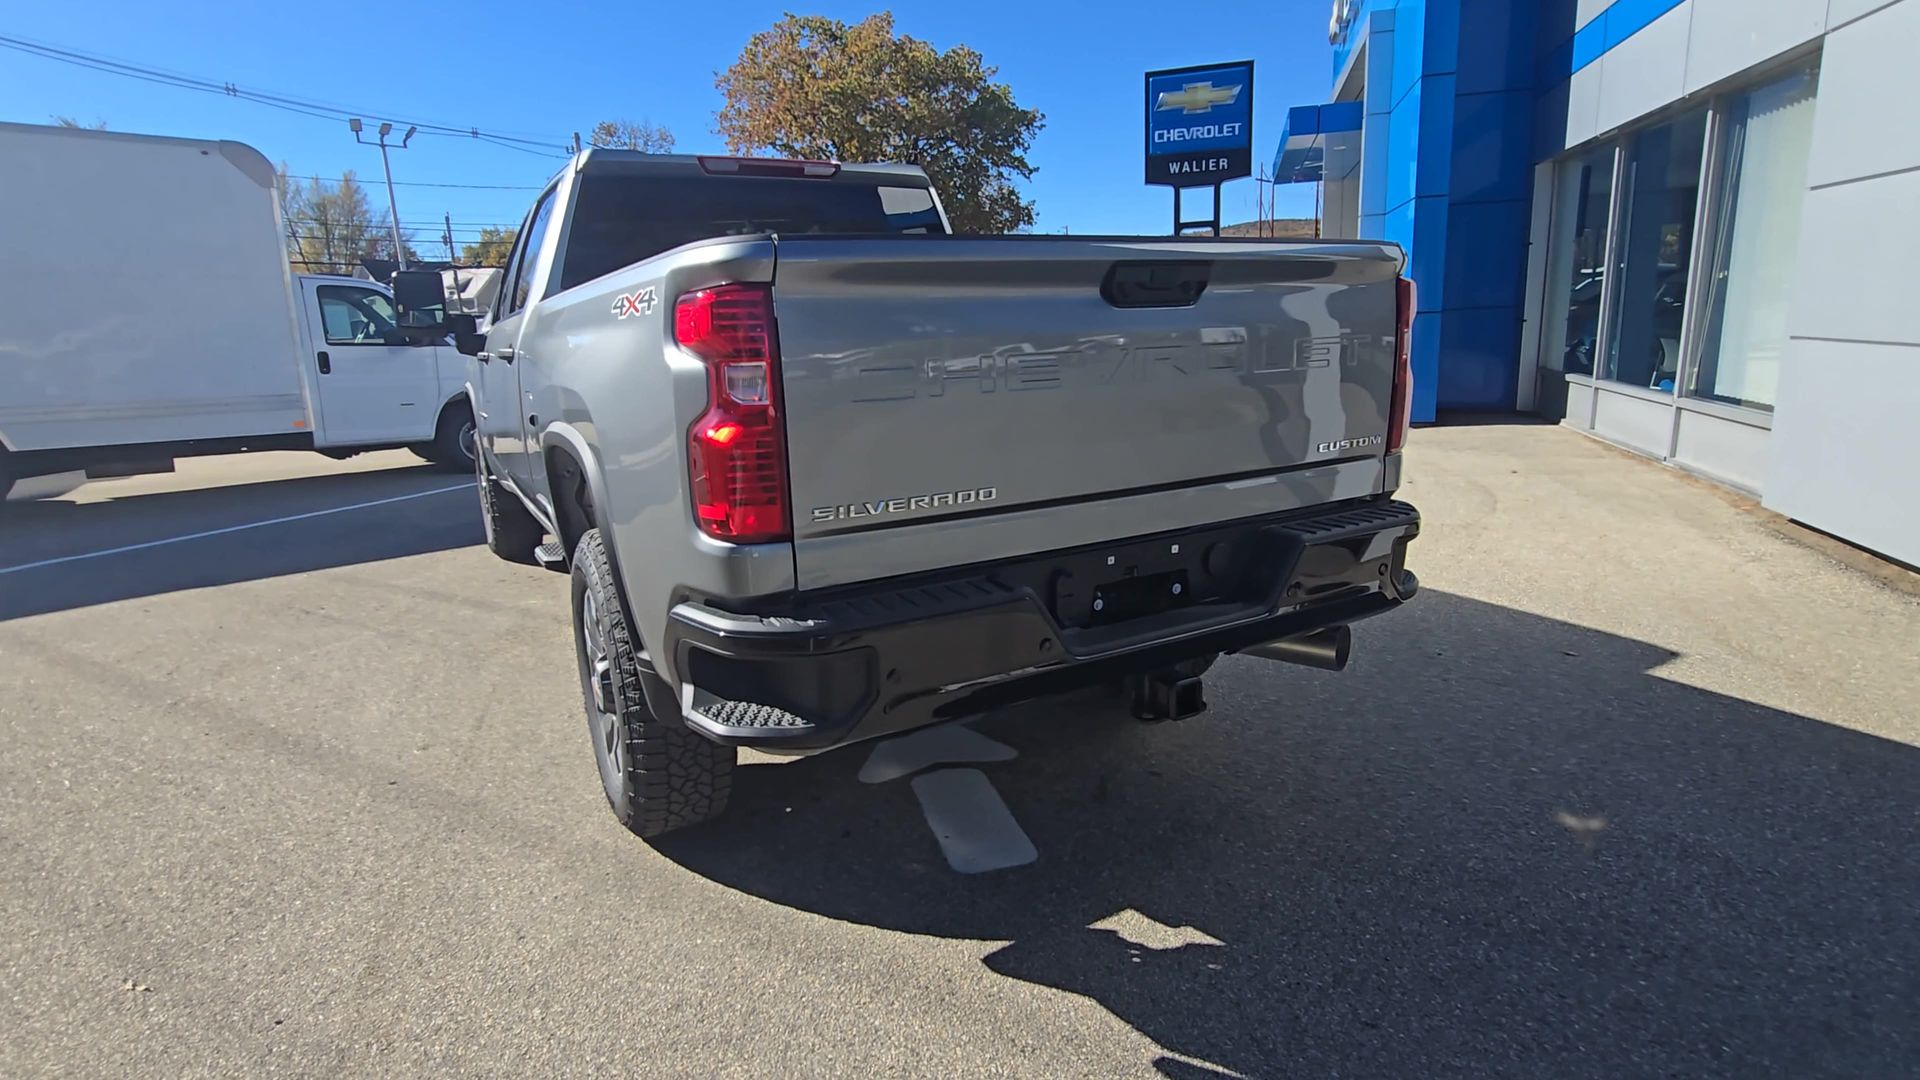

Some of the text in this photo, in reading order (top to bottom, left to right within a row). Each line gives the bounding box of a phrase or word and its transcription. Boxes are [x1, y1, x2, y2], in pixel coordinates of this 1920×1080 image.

[1154, 122, 1242, 143] CHEVROLET
[1168, 158, 1229, 174] WALIER
[1317, 435, 1382, 453] CUSTOM
[812, 487, 997, 522] SILVERADO
